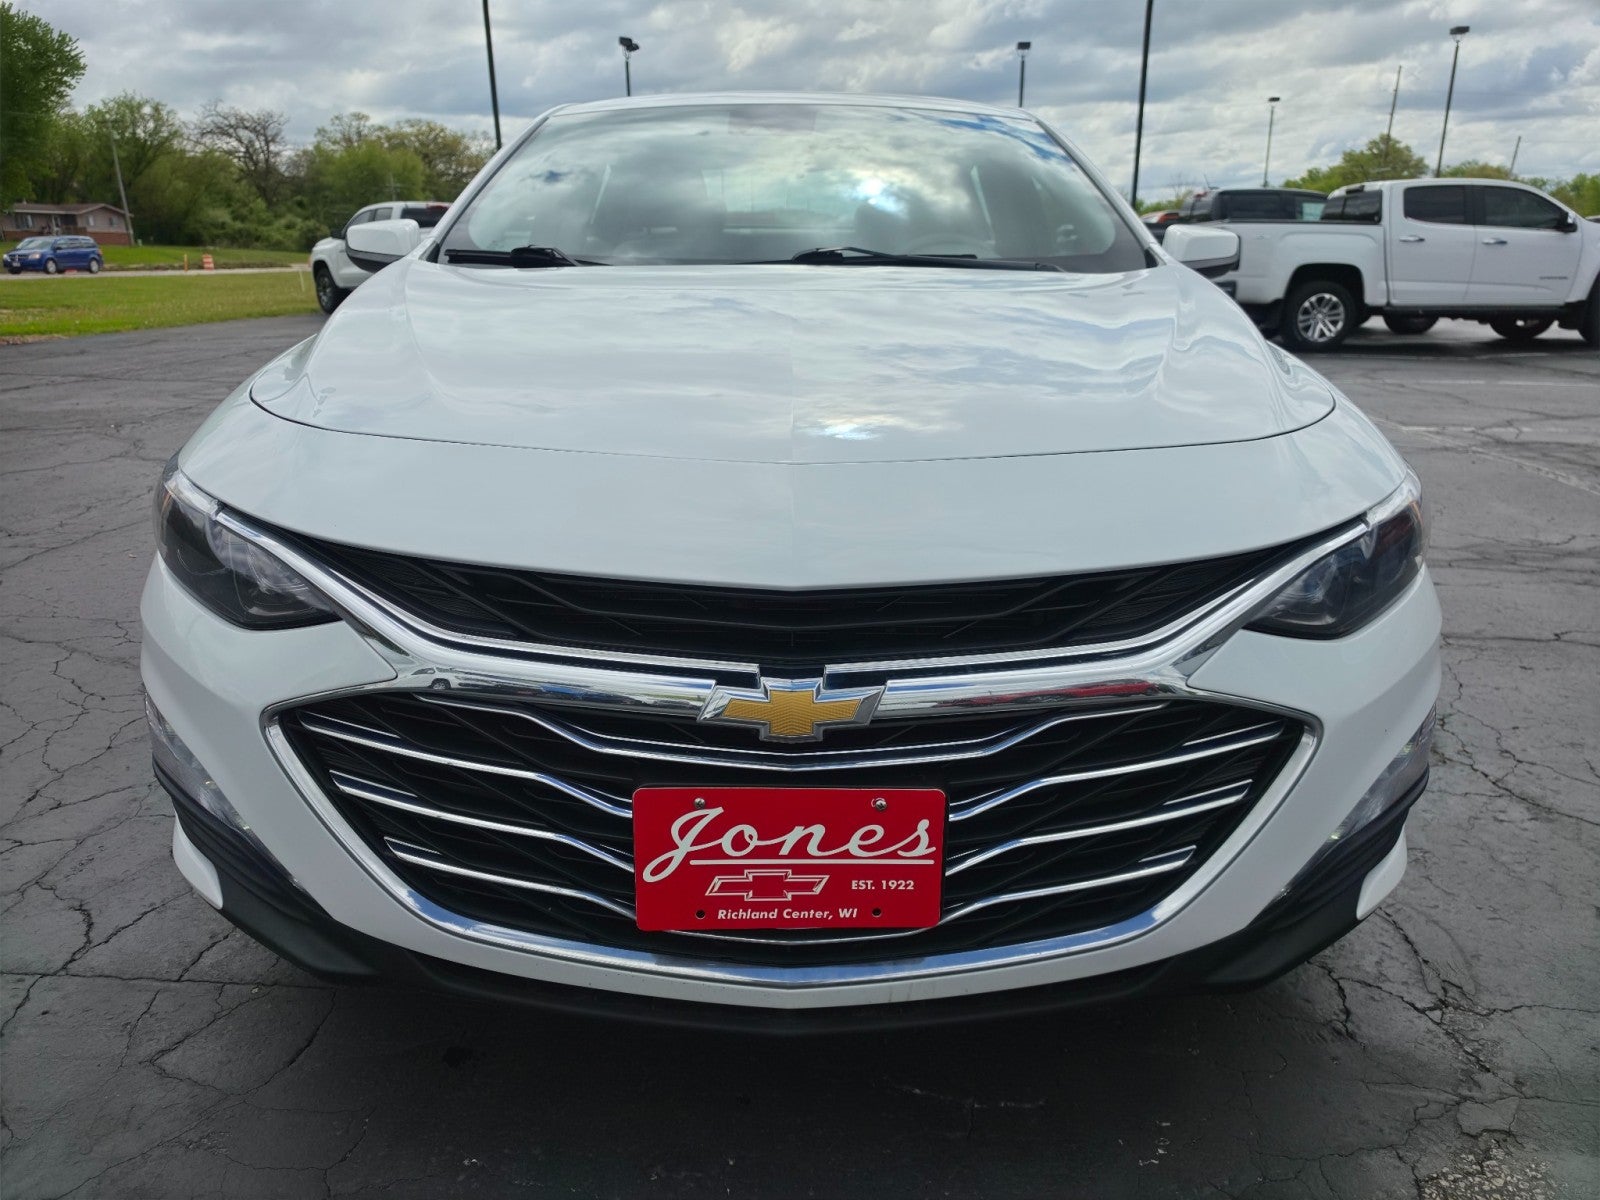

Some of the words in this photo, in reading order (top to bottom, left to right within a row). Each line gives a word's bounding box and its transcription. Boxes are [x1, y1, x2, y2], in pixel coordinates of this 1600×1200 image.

[643, 806, 936, 882] Jones
[851, 880, 875, 890] EST.
[881, 880, 914, 890] 1922
[717, 908, 777, 920] Richland
[783, 908, 833, 920] Center,
[838, 908, 857, 919] WI
